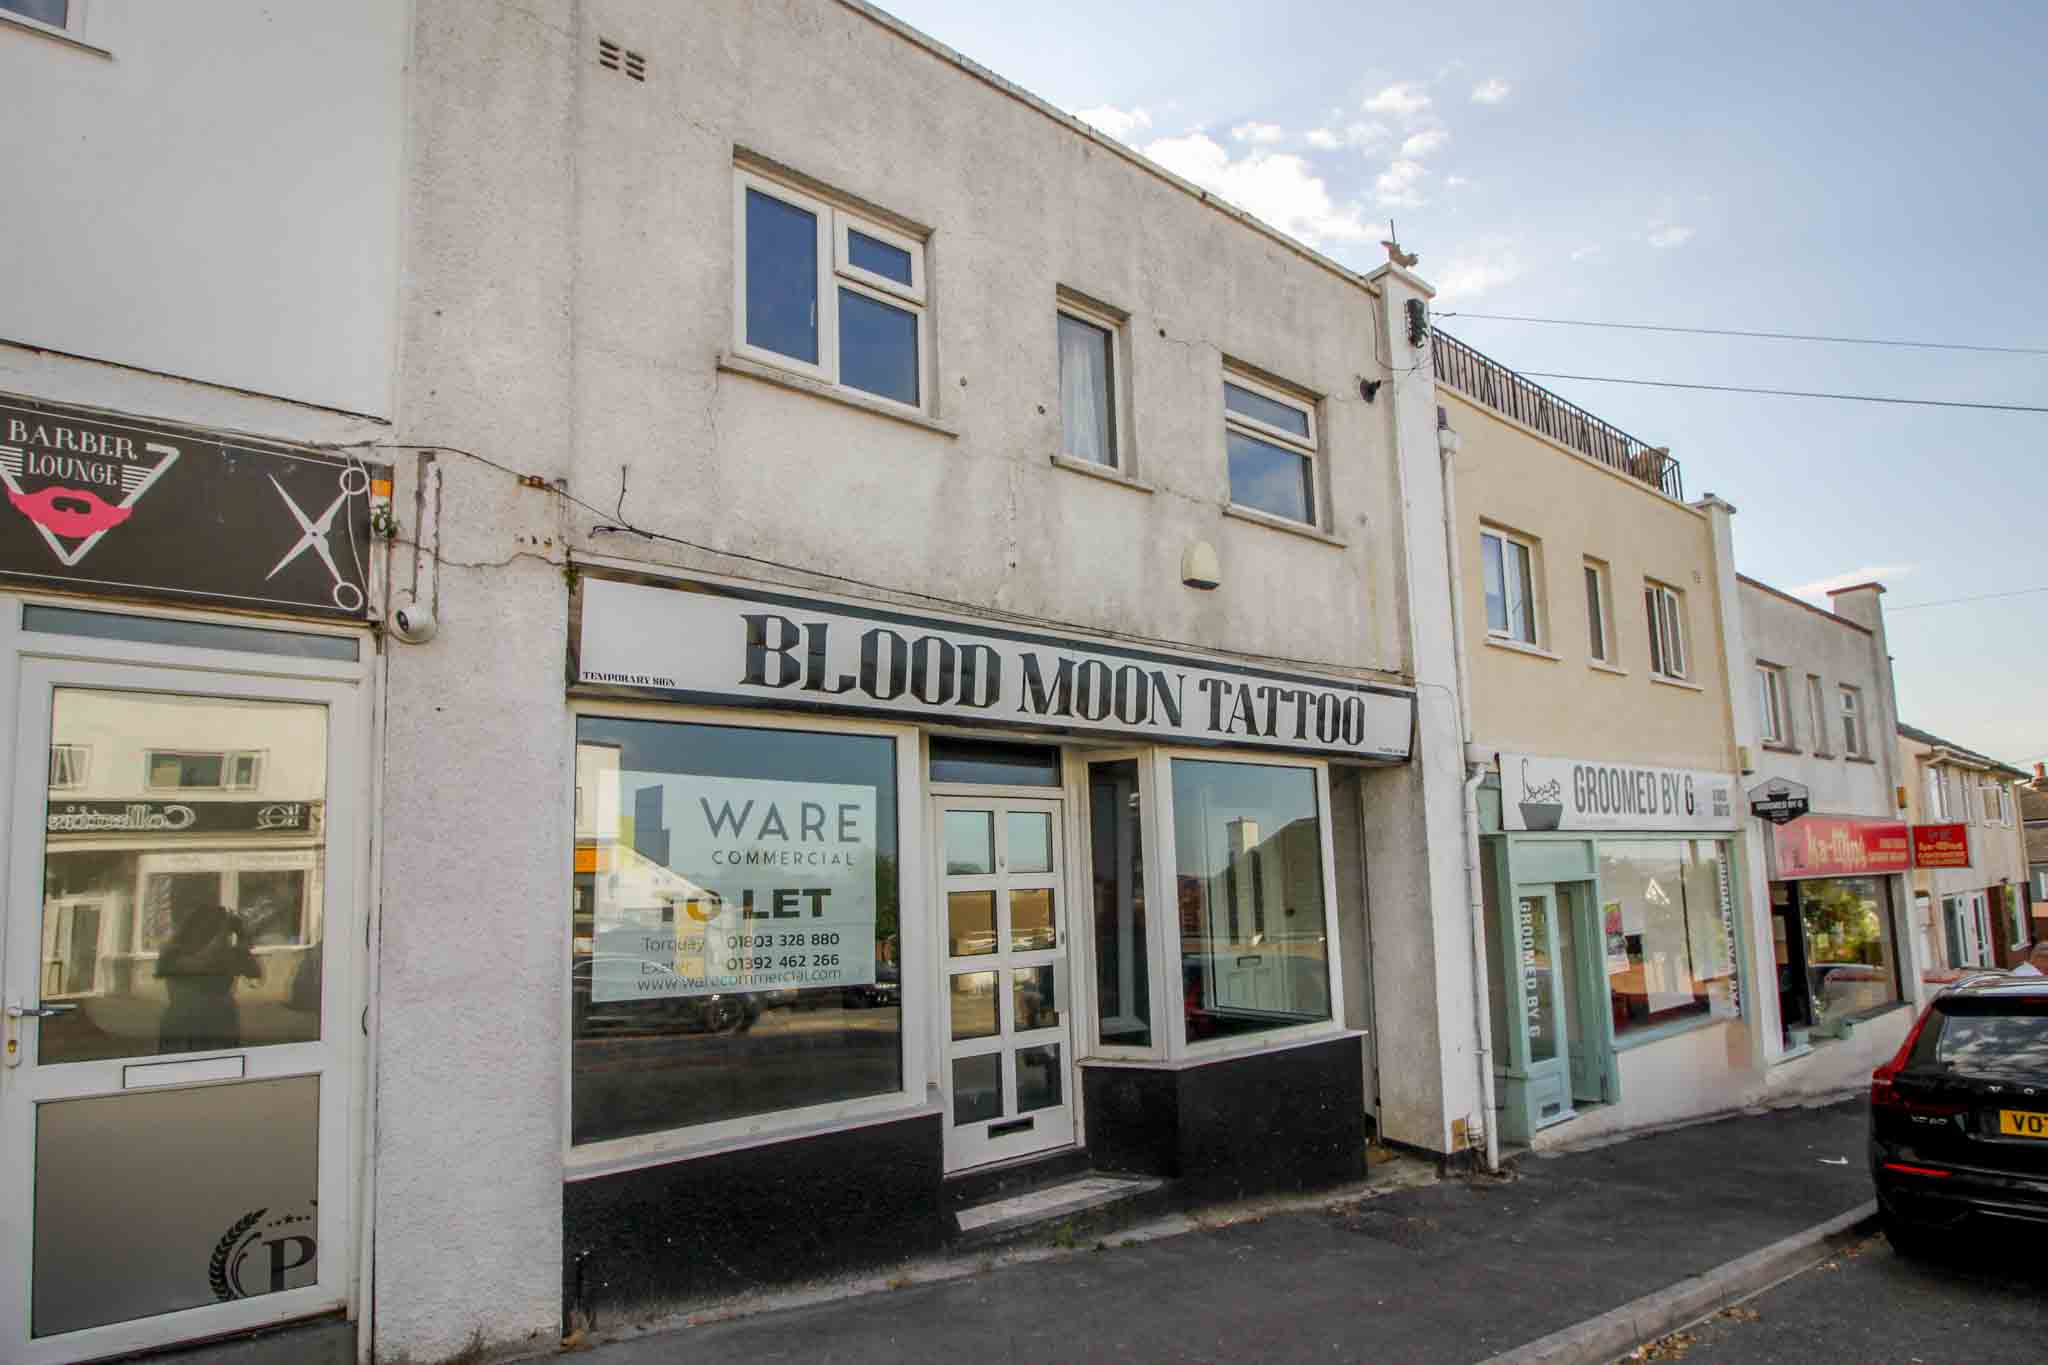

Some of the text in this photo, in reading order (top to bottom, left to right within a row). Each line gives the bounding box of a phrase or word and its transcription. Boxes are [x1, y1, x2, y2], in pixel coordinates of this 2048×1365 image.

[7, 419, 139, 461] BARBER
[28, 451, 119, 487] LOUNGE
[583, 671, 676, 687] TEMPORARY SIGN
[738, 613, 1367, 746] BLOOD MOON TATTOO
[1573, 764, 1695, 817] GROOMED BY G
[700, 797, 862, 843] WARE
[711, 849, 855, 867] COMMERCIAL
[742, 888, 832, 920] LET
[727, 935, 773, 949] 01803
[779, 934, 805, 947] 328
[811, 932, 840, 946] 880
[1520, 901, 1538, 990] GROOMED
[726, 956, 773, 970] 01392
[778, 955, 806, 968] 462
[813, 953, 840, 967] 266
[1527, 994, 1541, 1022] BY
